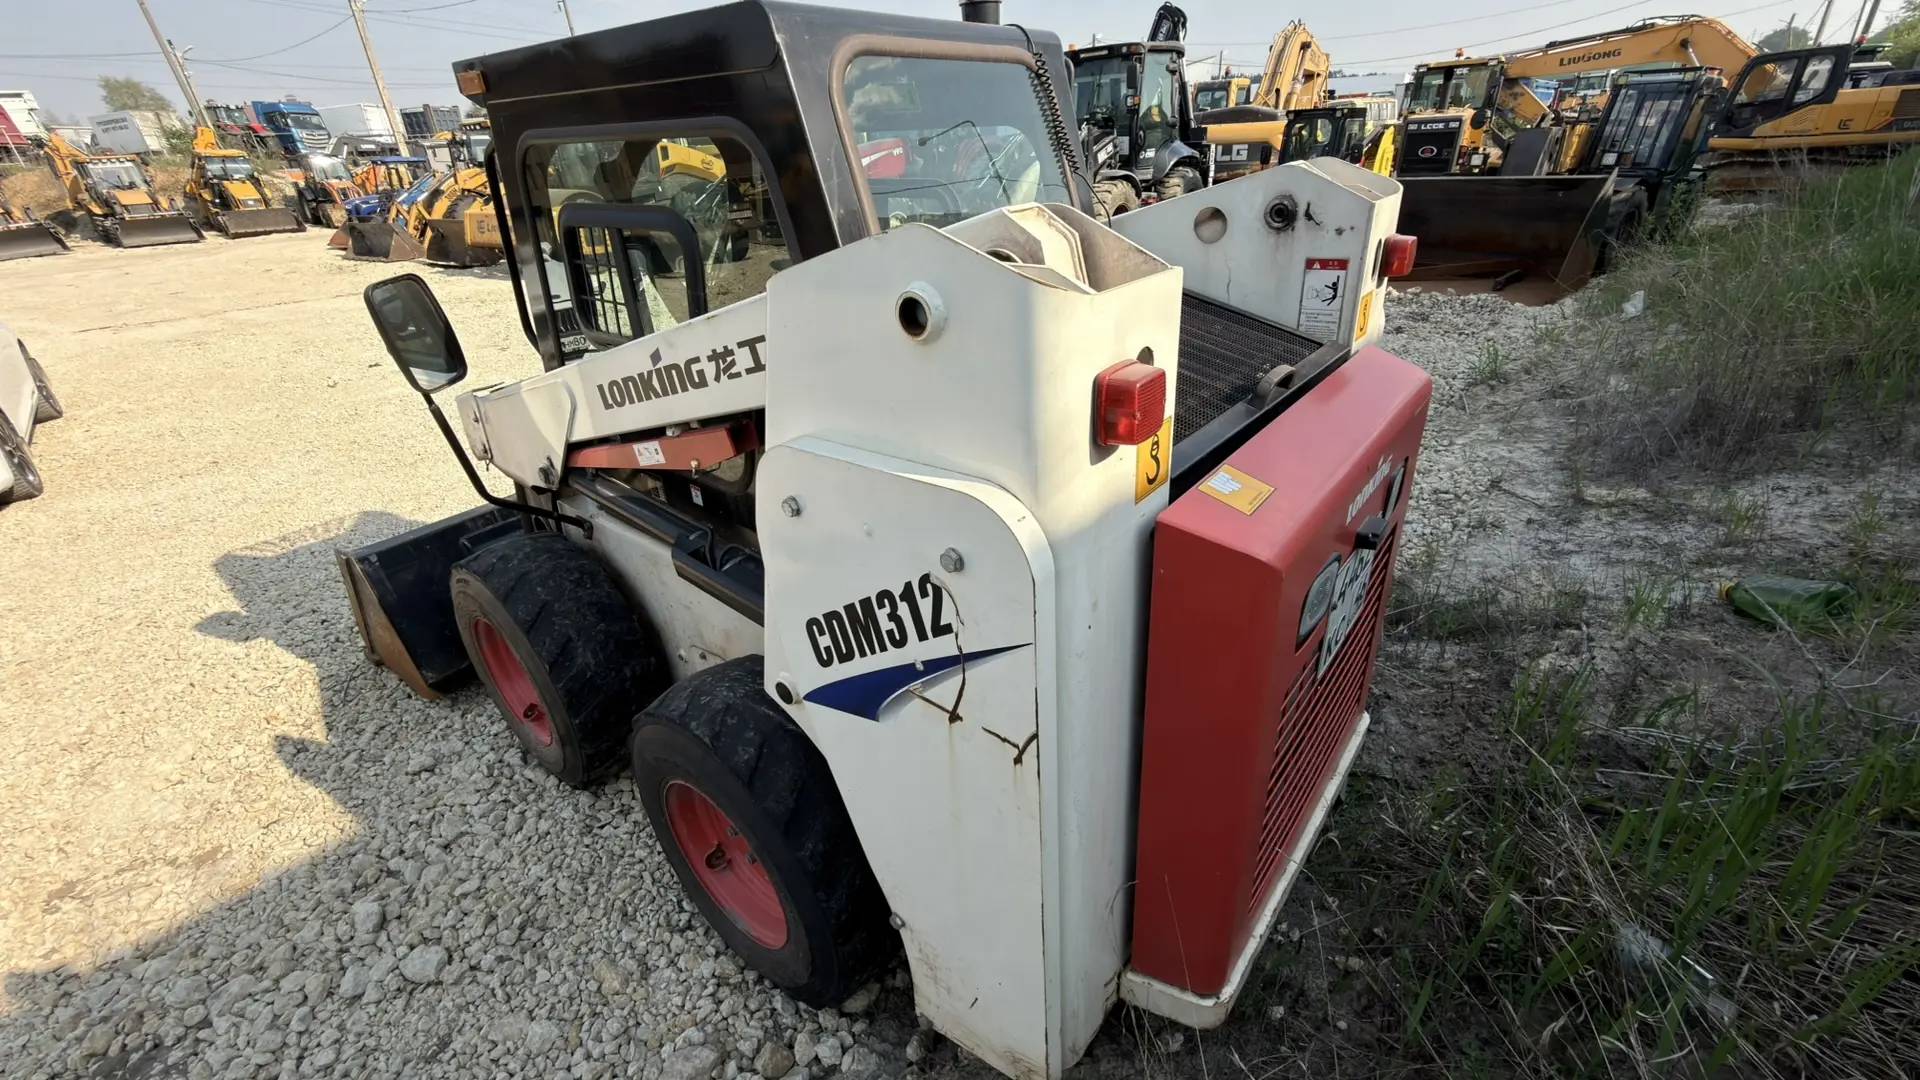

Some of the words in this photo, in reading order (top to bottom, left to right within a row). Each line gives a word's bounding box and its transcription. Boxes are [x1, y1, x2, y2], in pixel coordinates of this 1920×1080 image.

[1559, 47, 1623, 67] LIUGONG
[1216, 143, 1249, 162] LG
[805, 571, 955, 669] CDM312
